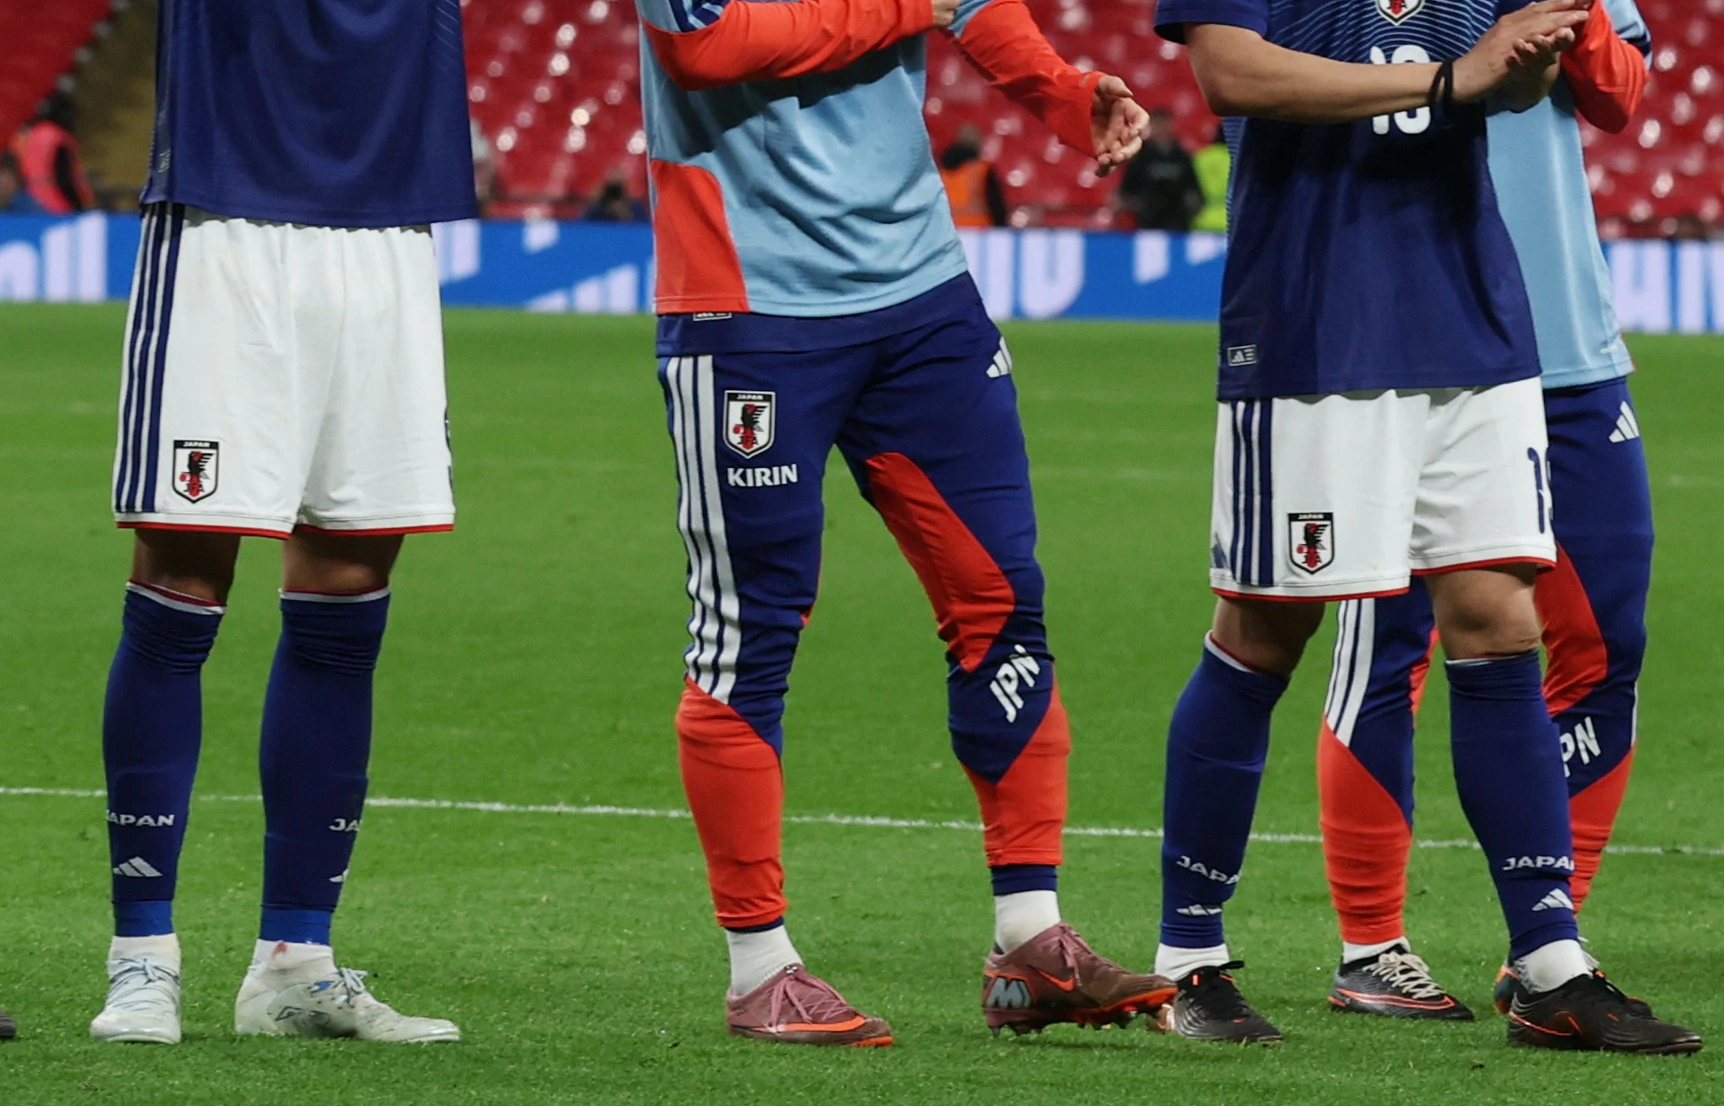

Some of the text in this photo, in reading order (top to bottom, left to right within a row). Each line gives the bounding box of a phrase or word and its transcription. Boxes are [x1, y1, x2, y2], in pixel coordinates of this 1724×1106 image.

[727, 463, 798, 487] KIRIN
[1527, 447, 1554, 534] 1
[989, 644, 1041, 723] JPN
[1559, 716, 1601, 778] PN
[1502, 855, 1575, 871] JAPA
